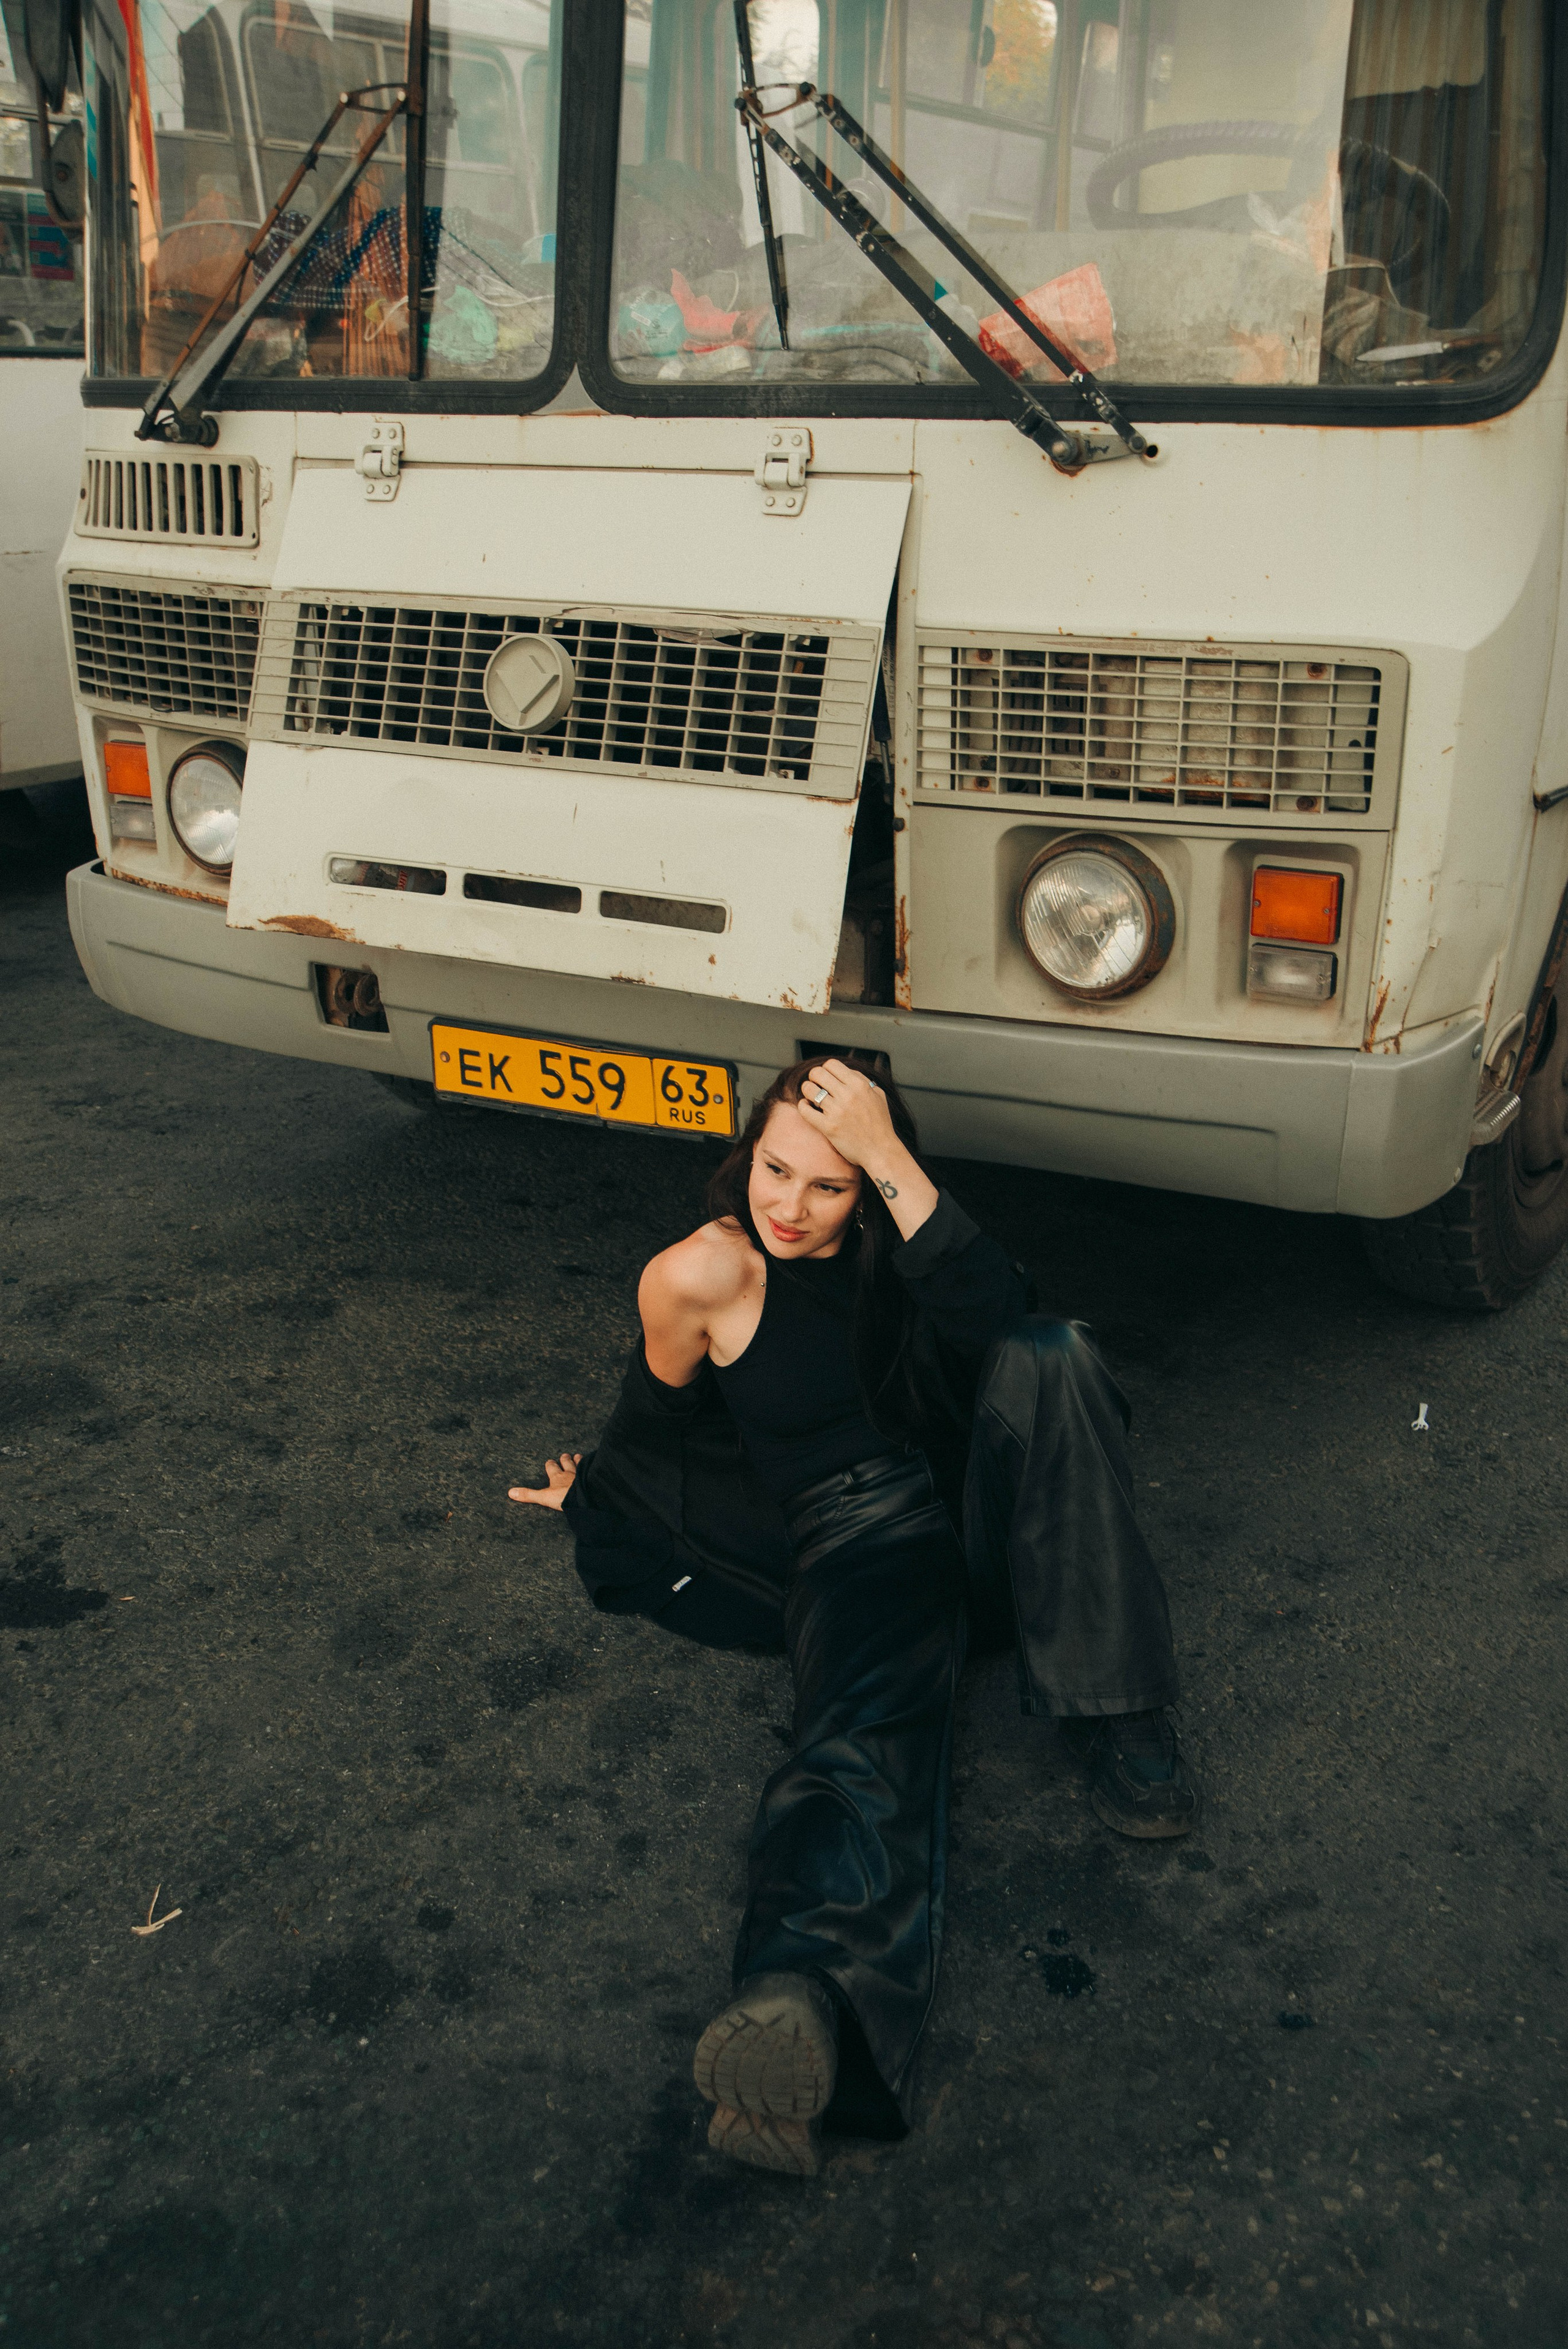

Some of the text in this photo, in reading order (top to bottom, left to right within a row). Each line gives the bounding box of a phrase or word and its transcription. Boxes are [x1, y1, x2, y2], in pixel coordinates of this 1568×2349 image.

[459, 1048, 709, 1110] EK 559 63
[669, 1107, 706, 1125] RUS
